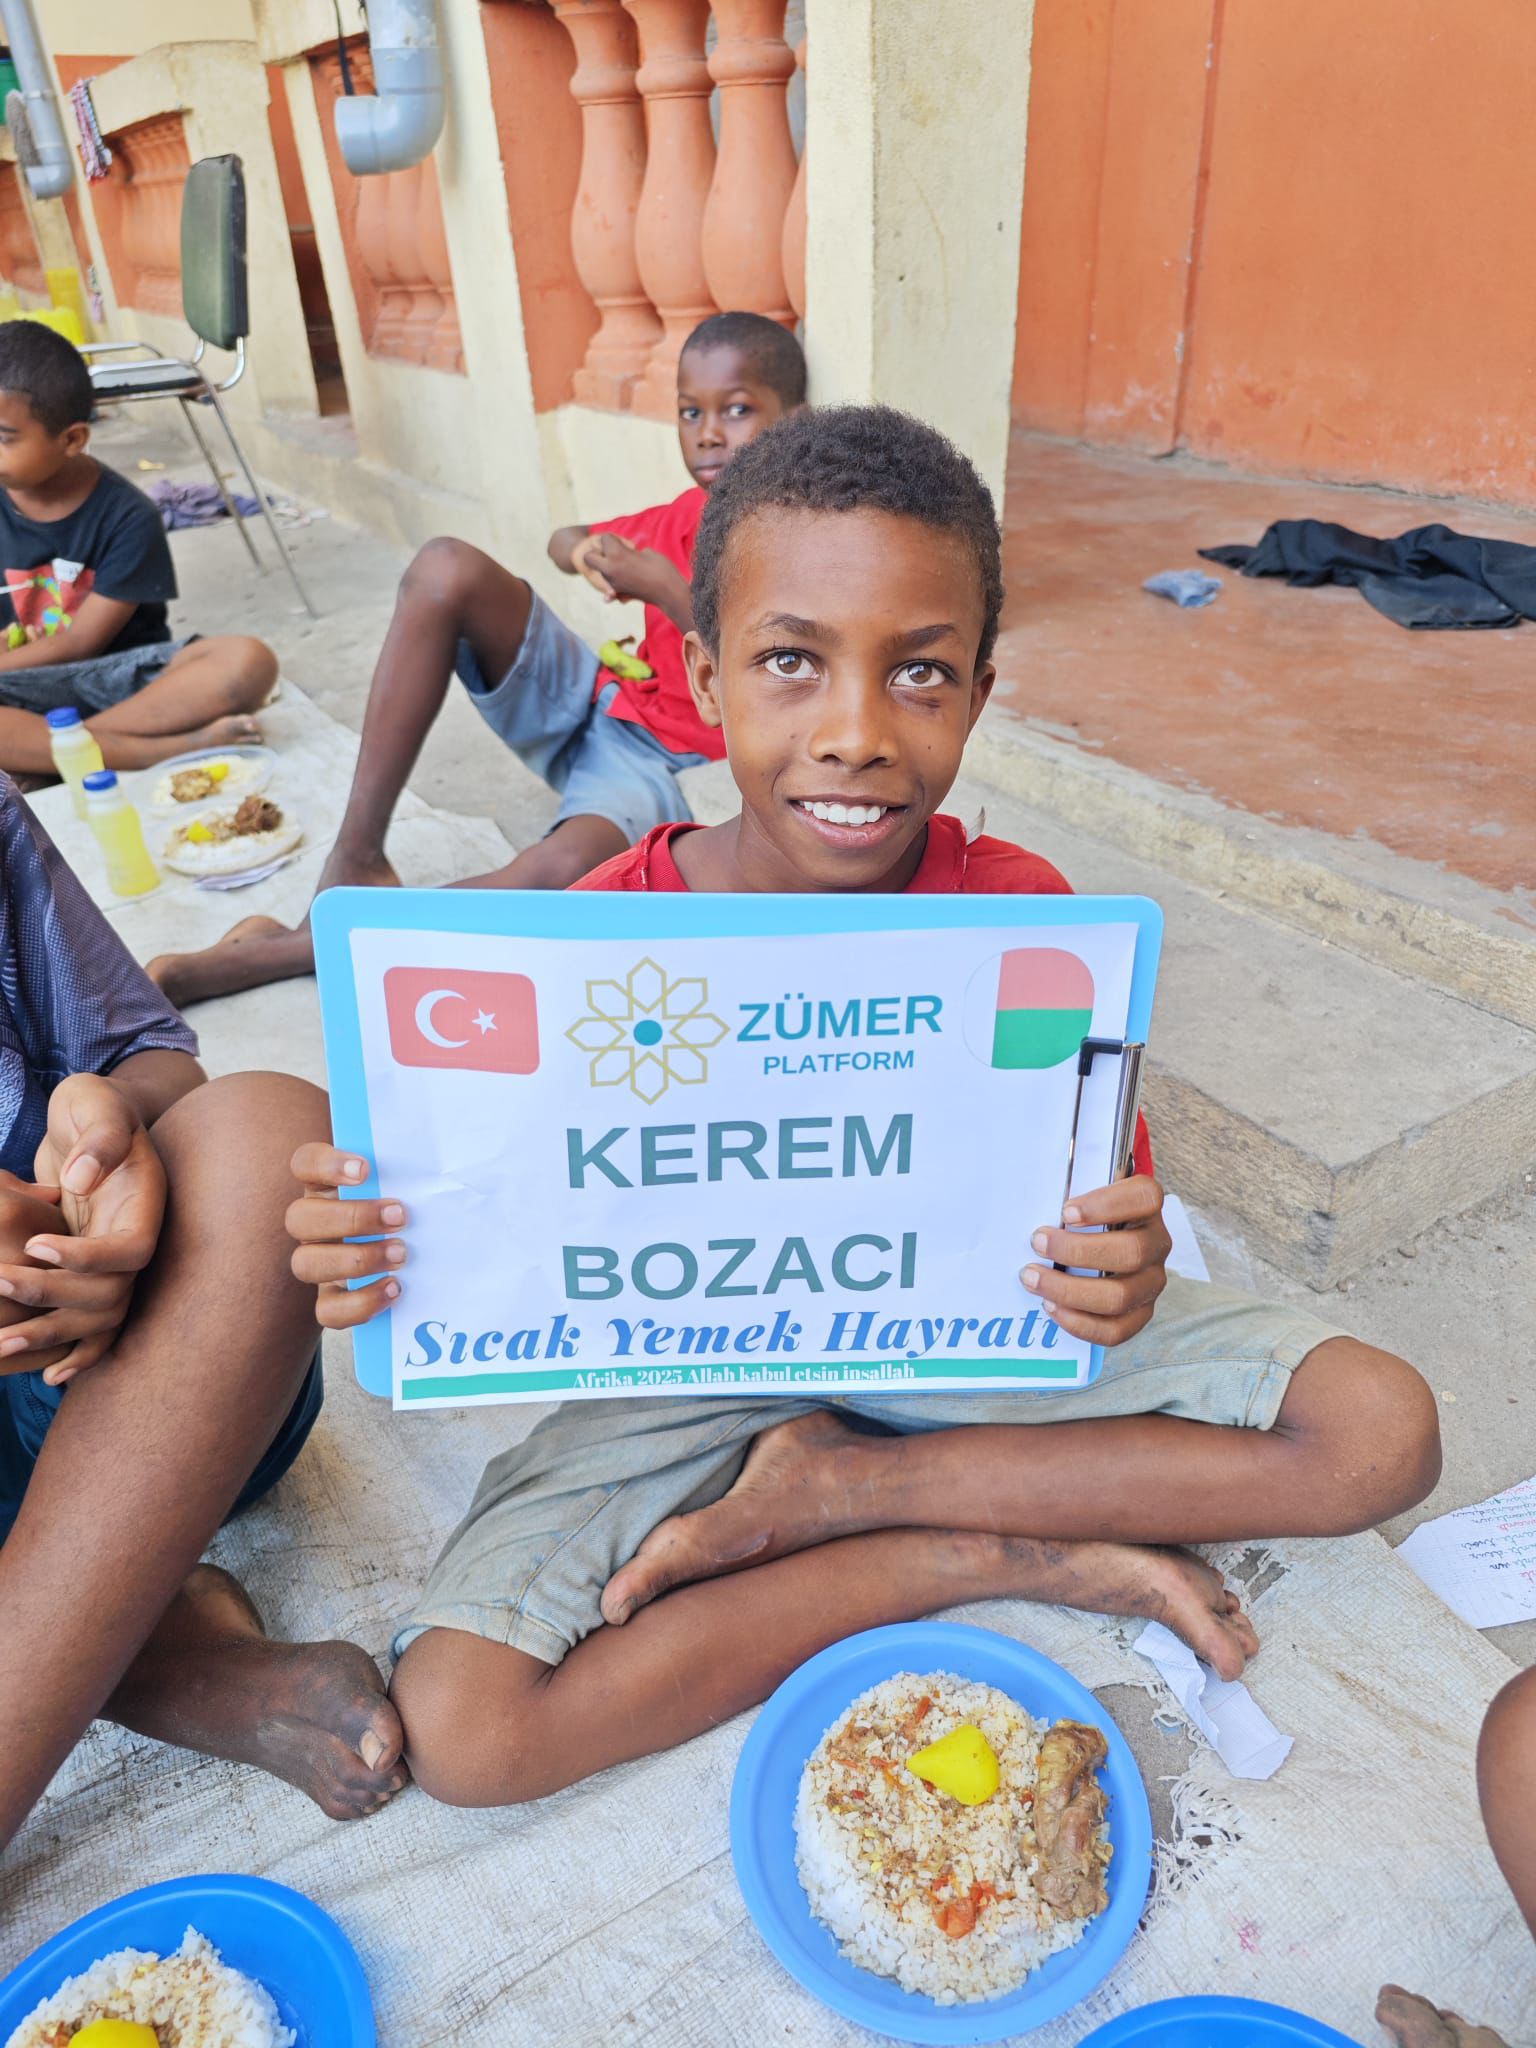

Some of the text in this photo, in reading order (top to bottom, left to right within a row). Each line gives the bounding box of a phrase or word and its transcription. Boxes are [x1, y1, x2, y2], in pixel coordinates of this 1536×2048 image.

[737, 992, 943, 1042] ZÜMER
[763, 1050, 914, 1075] PLATFORM
[566, 1113, 913, 1189] KEREM
[562, 1232, 917, 1300] BOZACI
[404, 1313, 581, 1368] Sıcak
[606, 1310, 803, 1357] Yemek
[573, 1371, 633, 1389] Afrika
[637, 1369, 683, 1386] 2025
[687, 1366, 736, 1385] Allah
[739, 1365, 791, 1383] kabul
[794, 1365, 839, 1382] etsin
